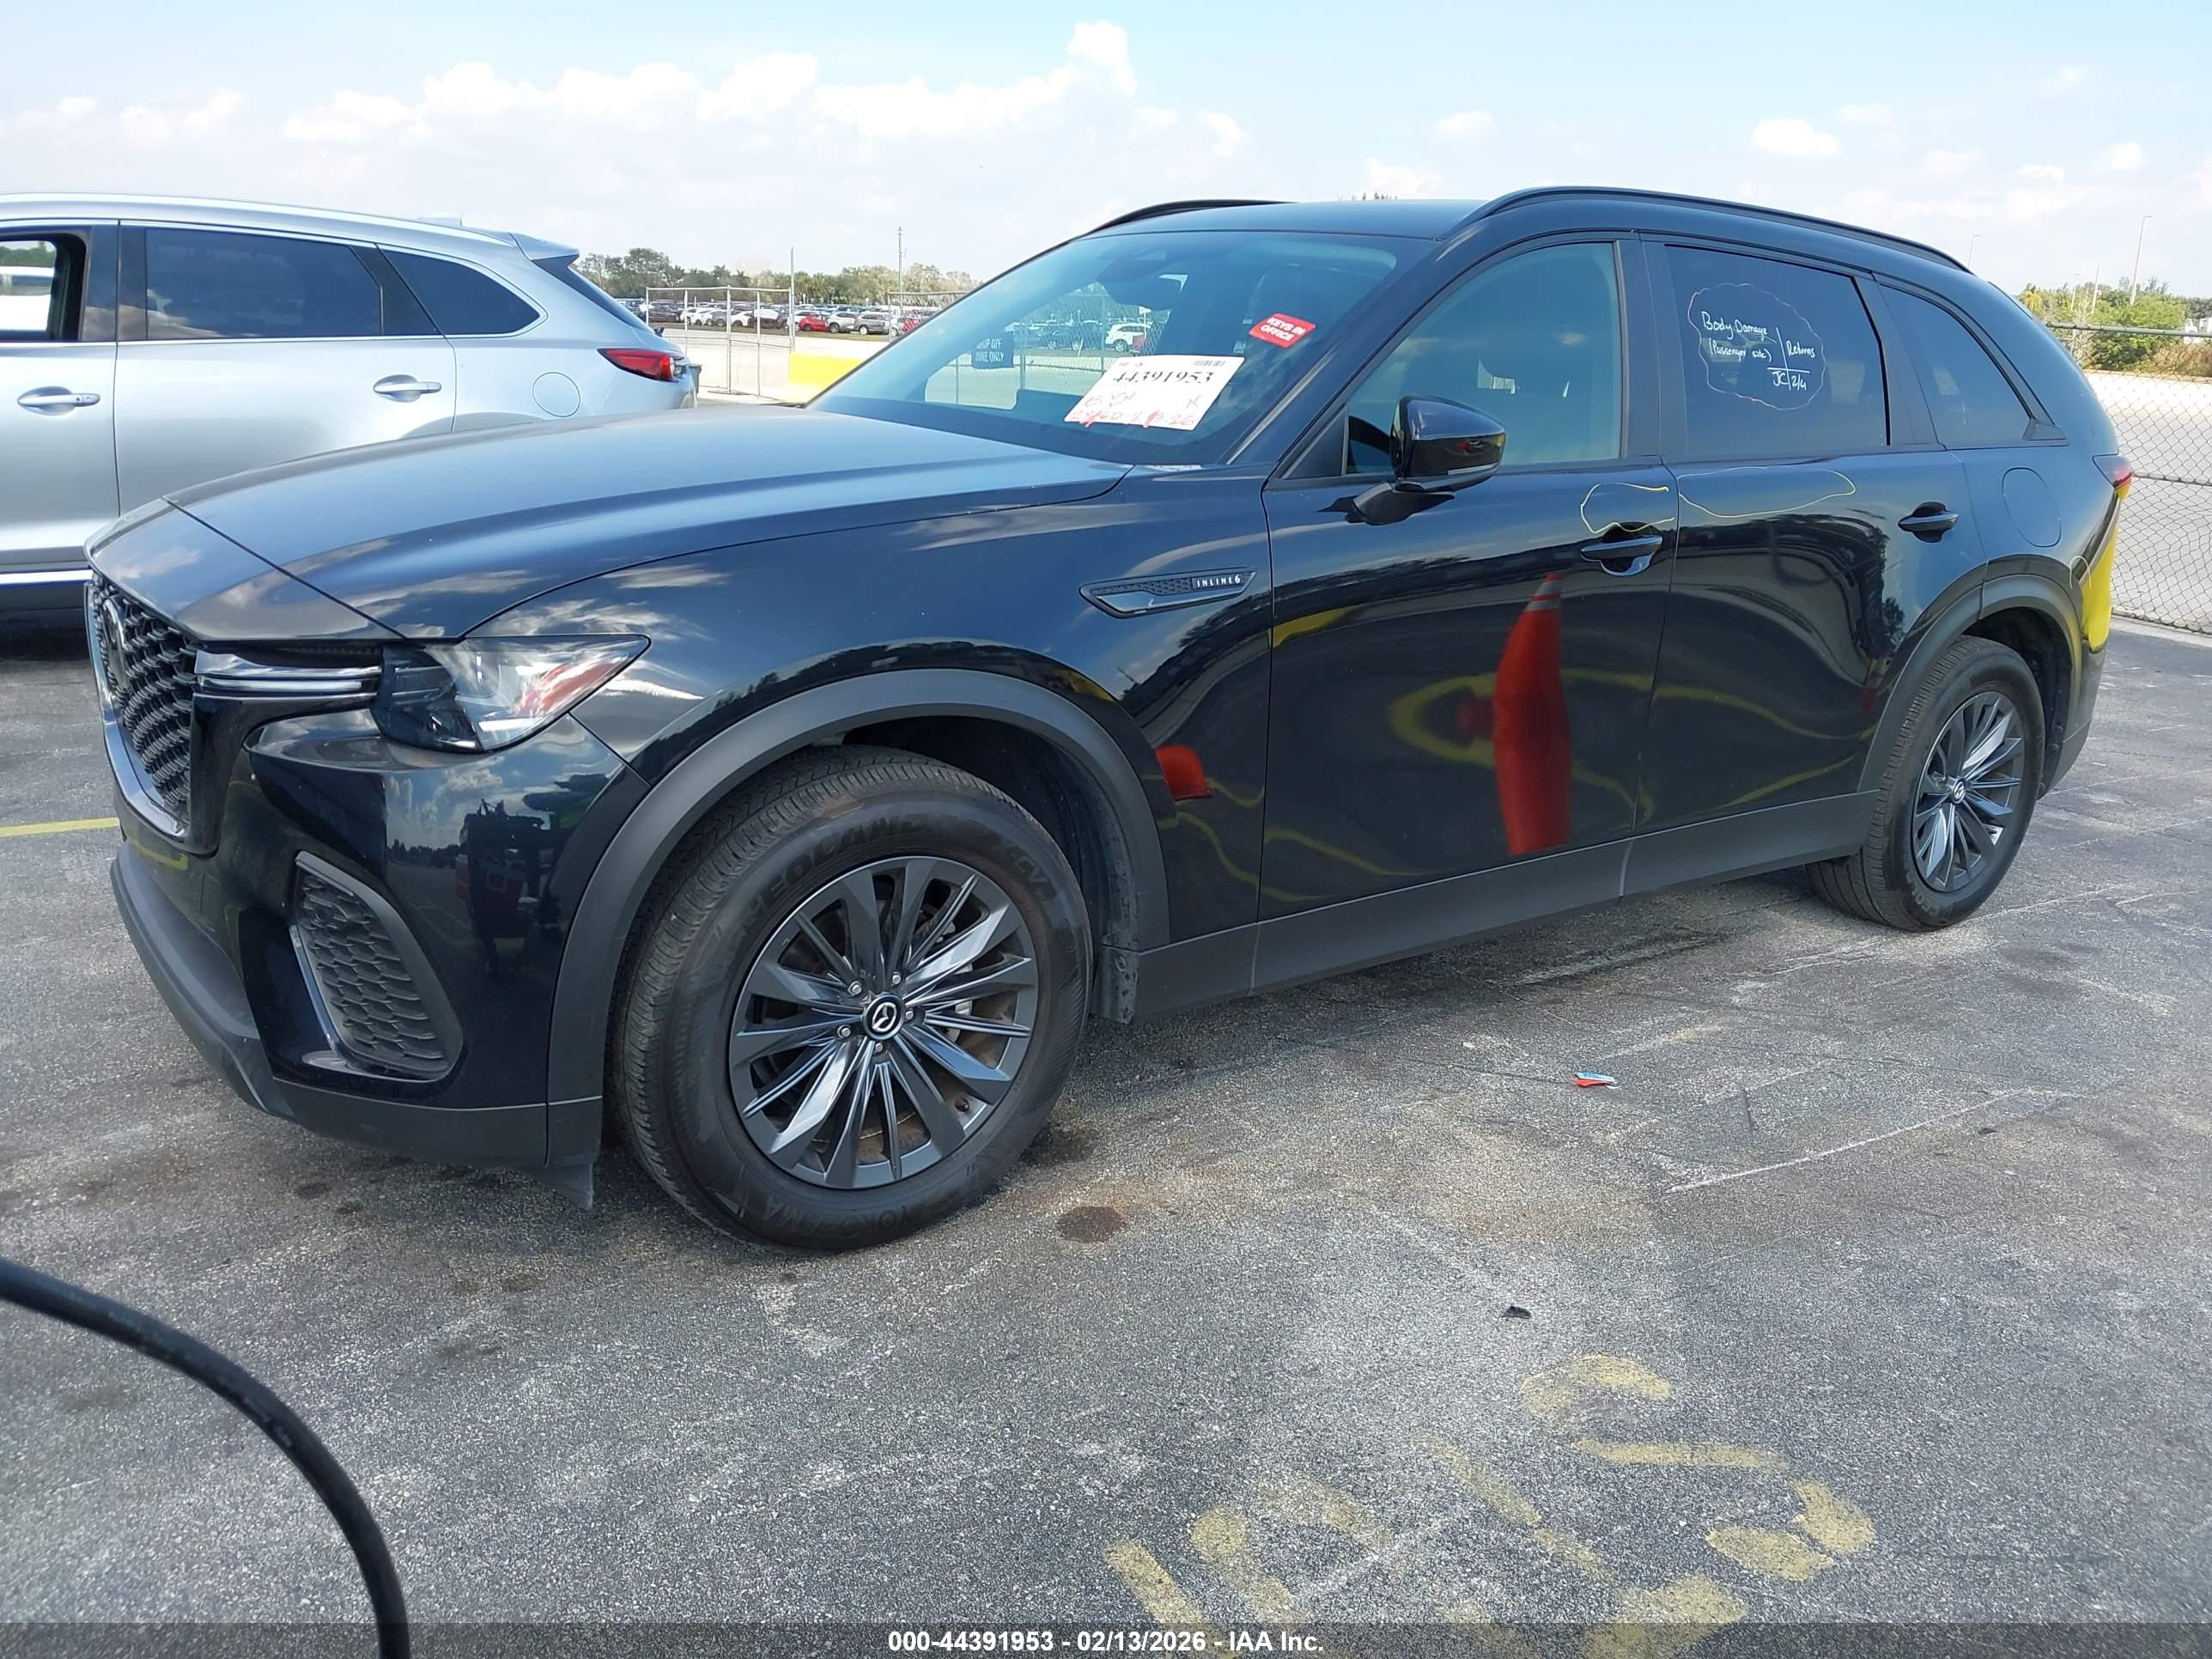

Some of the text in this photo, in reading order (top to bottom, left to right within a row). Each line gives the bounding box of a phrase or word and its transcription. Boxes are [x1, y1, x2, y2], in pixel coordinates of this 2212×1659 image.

[1260, 324, 1295, 341] OFFICE
[1267, 317, 1306, 336] KEYS IN
[1701, 311, 1768, 342] Body Damage
[988, 350, 1005, 362] ONLY
[1113, 370, 1214, 384] 44391953
